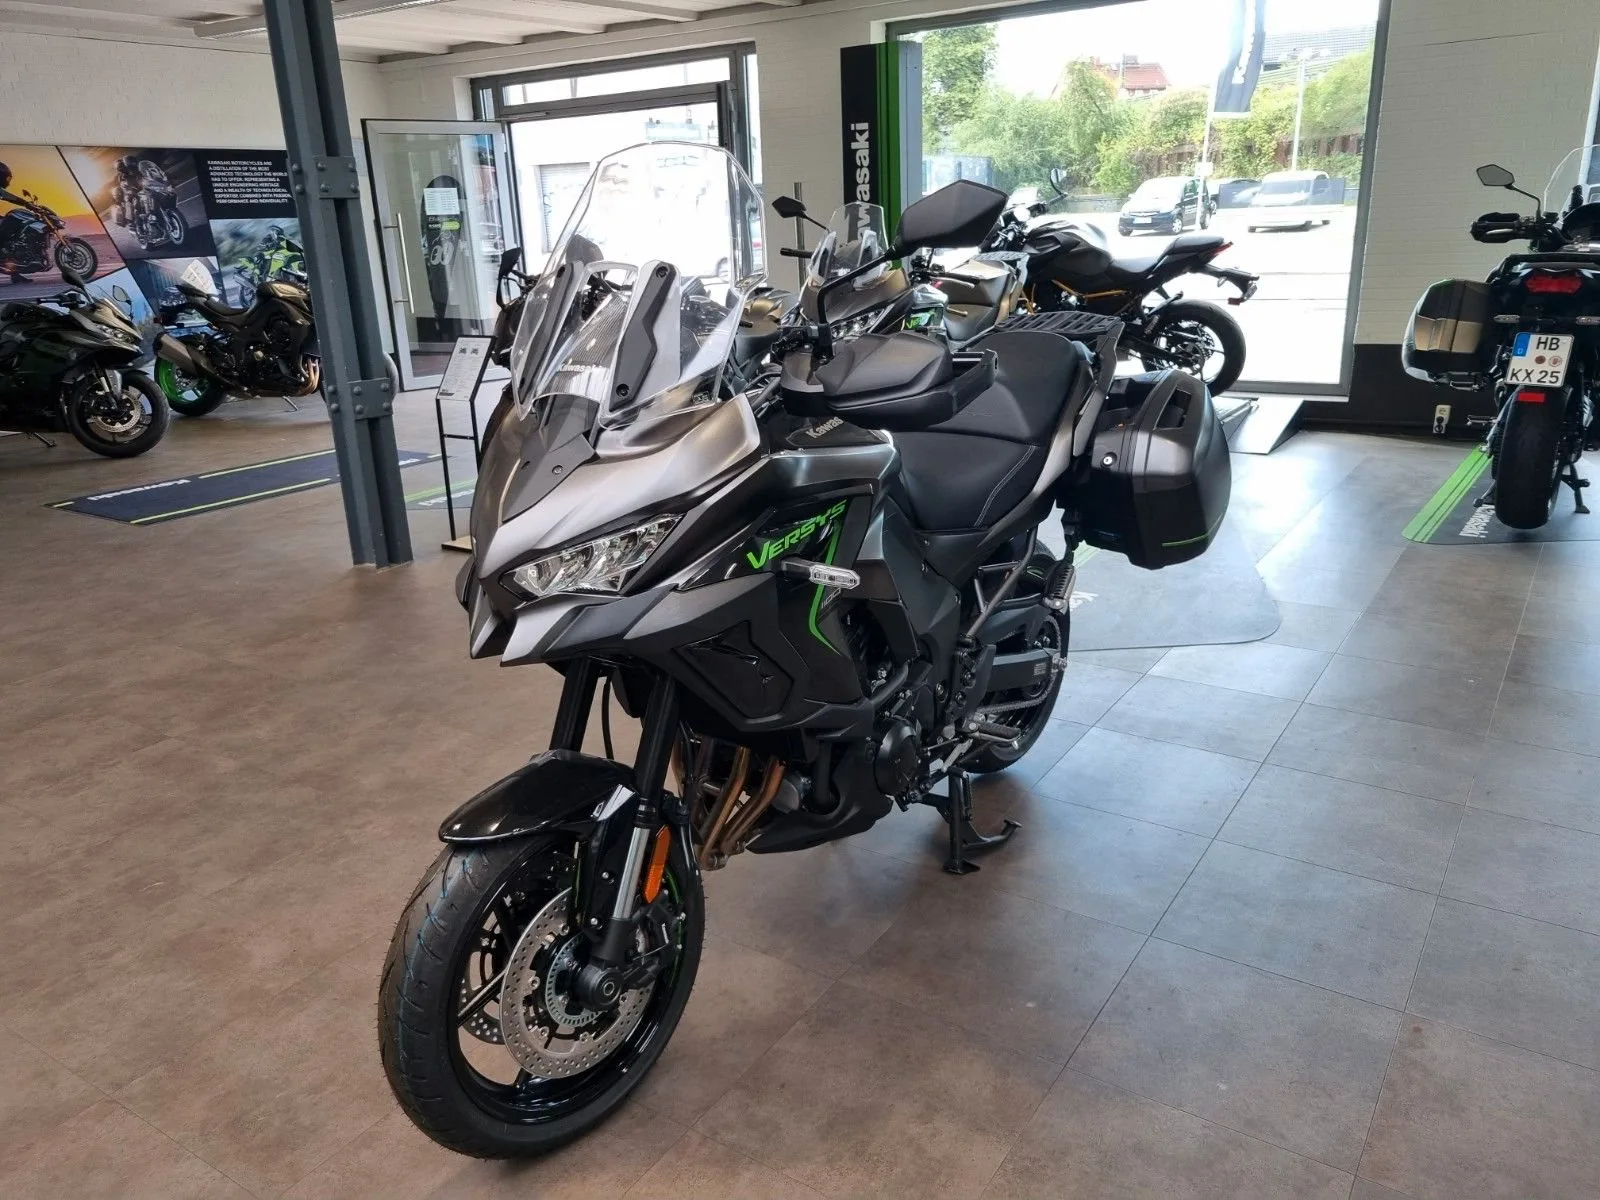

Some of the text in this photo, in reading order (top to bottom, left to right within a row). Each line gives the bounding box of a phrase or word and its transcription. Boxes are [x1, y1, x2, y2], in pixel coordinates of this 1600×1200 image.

[850, 122, 871, 241] awasaki
[1536, 336, 1560, 351] HB
[1509, 368, 1561, 384] KX 25
[805, 416, 844, 438] Kawas
[746, 499, 847, 569] VERSYS
[821, 587, 841, 609] 1100
